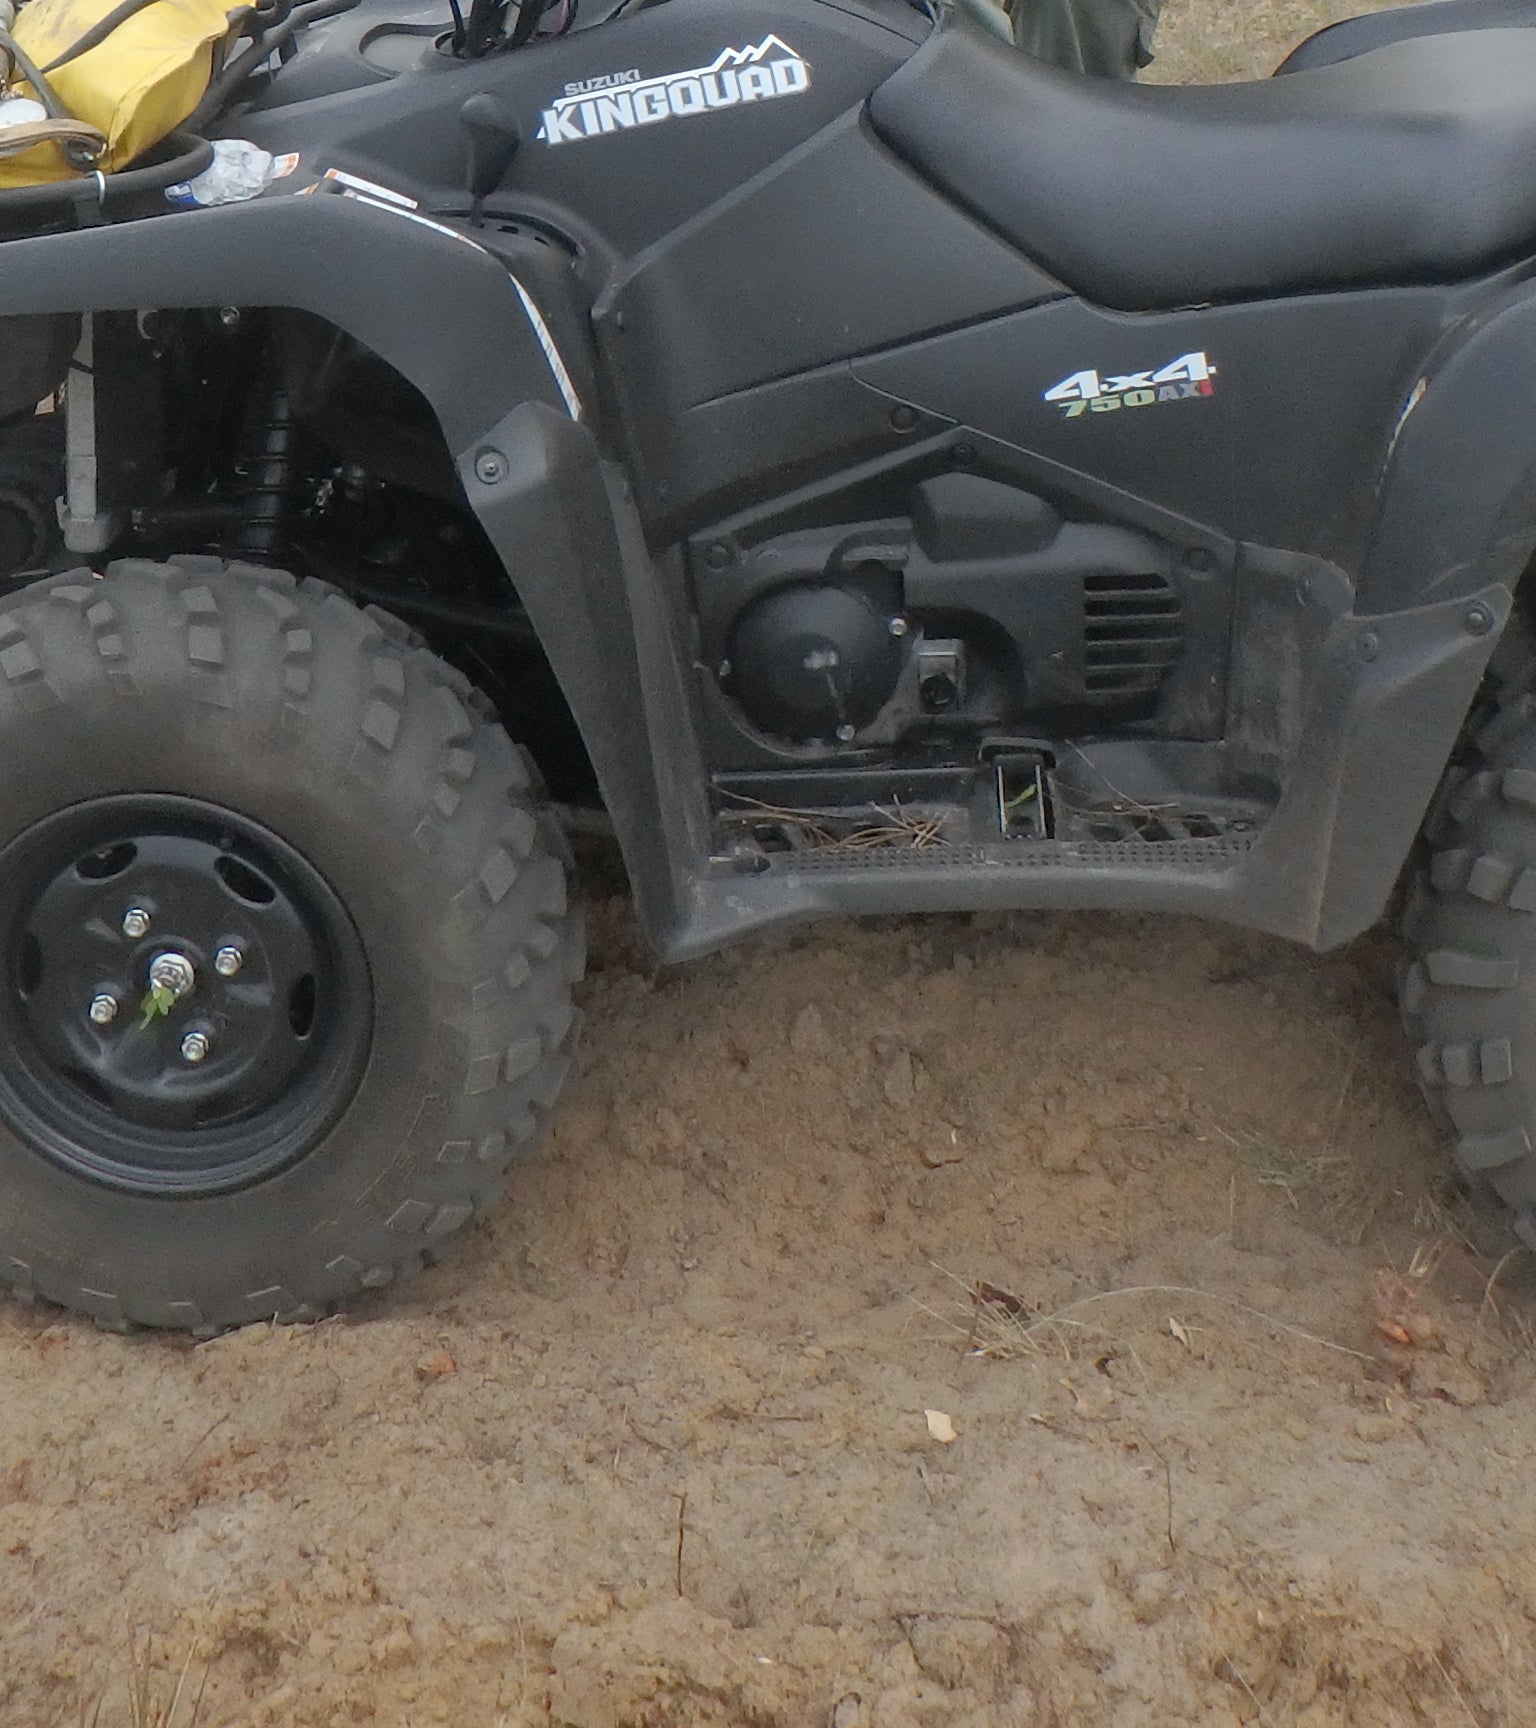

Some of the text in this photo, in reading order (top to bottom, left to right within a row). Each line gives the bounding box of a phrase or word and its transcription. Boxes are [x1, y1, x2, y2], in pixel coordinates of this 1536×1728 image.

[541, 58, 811, 145] KINGQUAD
[564, 68, 640, 97] SUZUKI
[1044, 351, 1217, 401] 4x4
